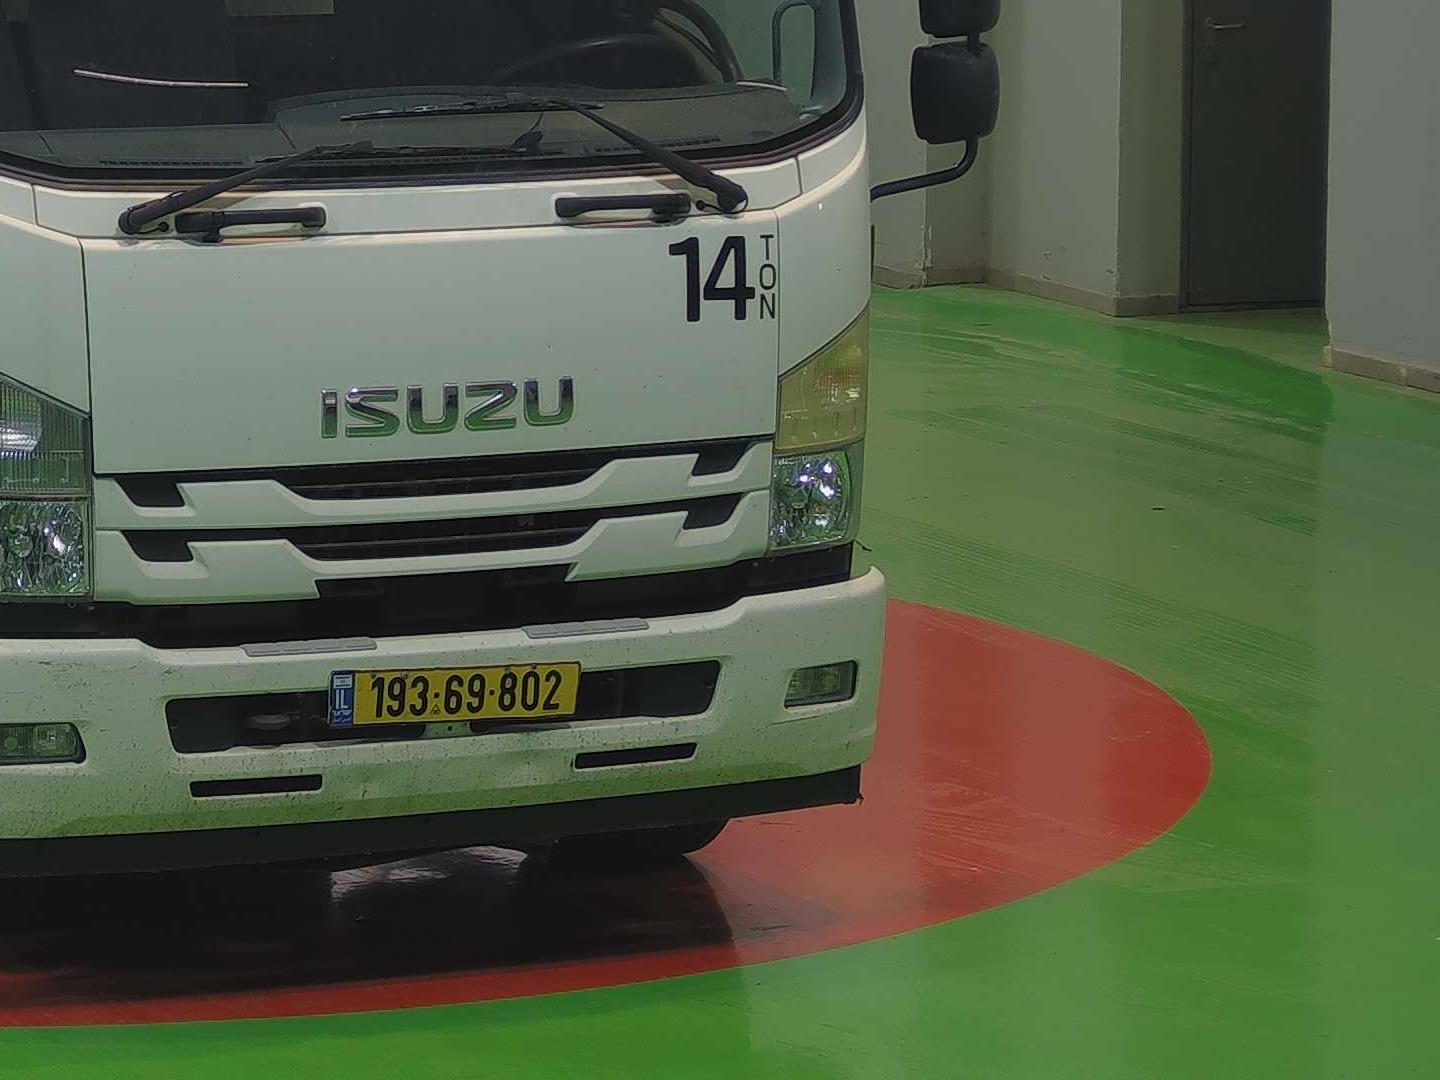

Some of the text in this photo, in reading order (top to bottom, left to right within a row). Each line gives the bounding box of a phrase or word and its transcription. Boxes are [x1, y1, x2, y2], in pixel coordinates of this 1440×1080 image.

[668, 233, 777, 323] 14 TON
[320, 375, 574, 438] ISUZU
[335, 688, 349, 710] IL
